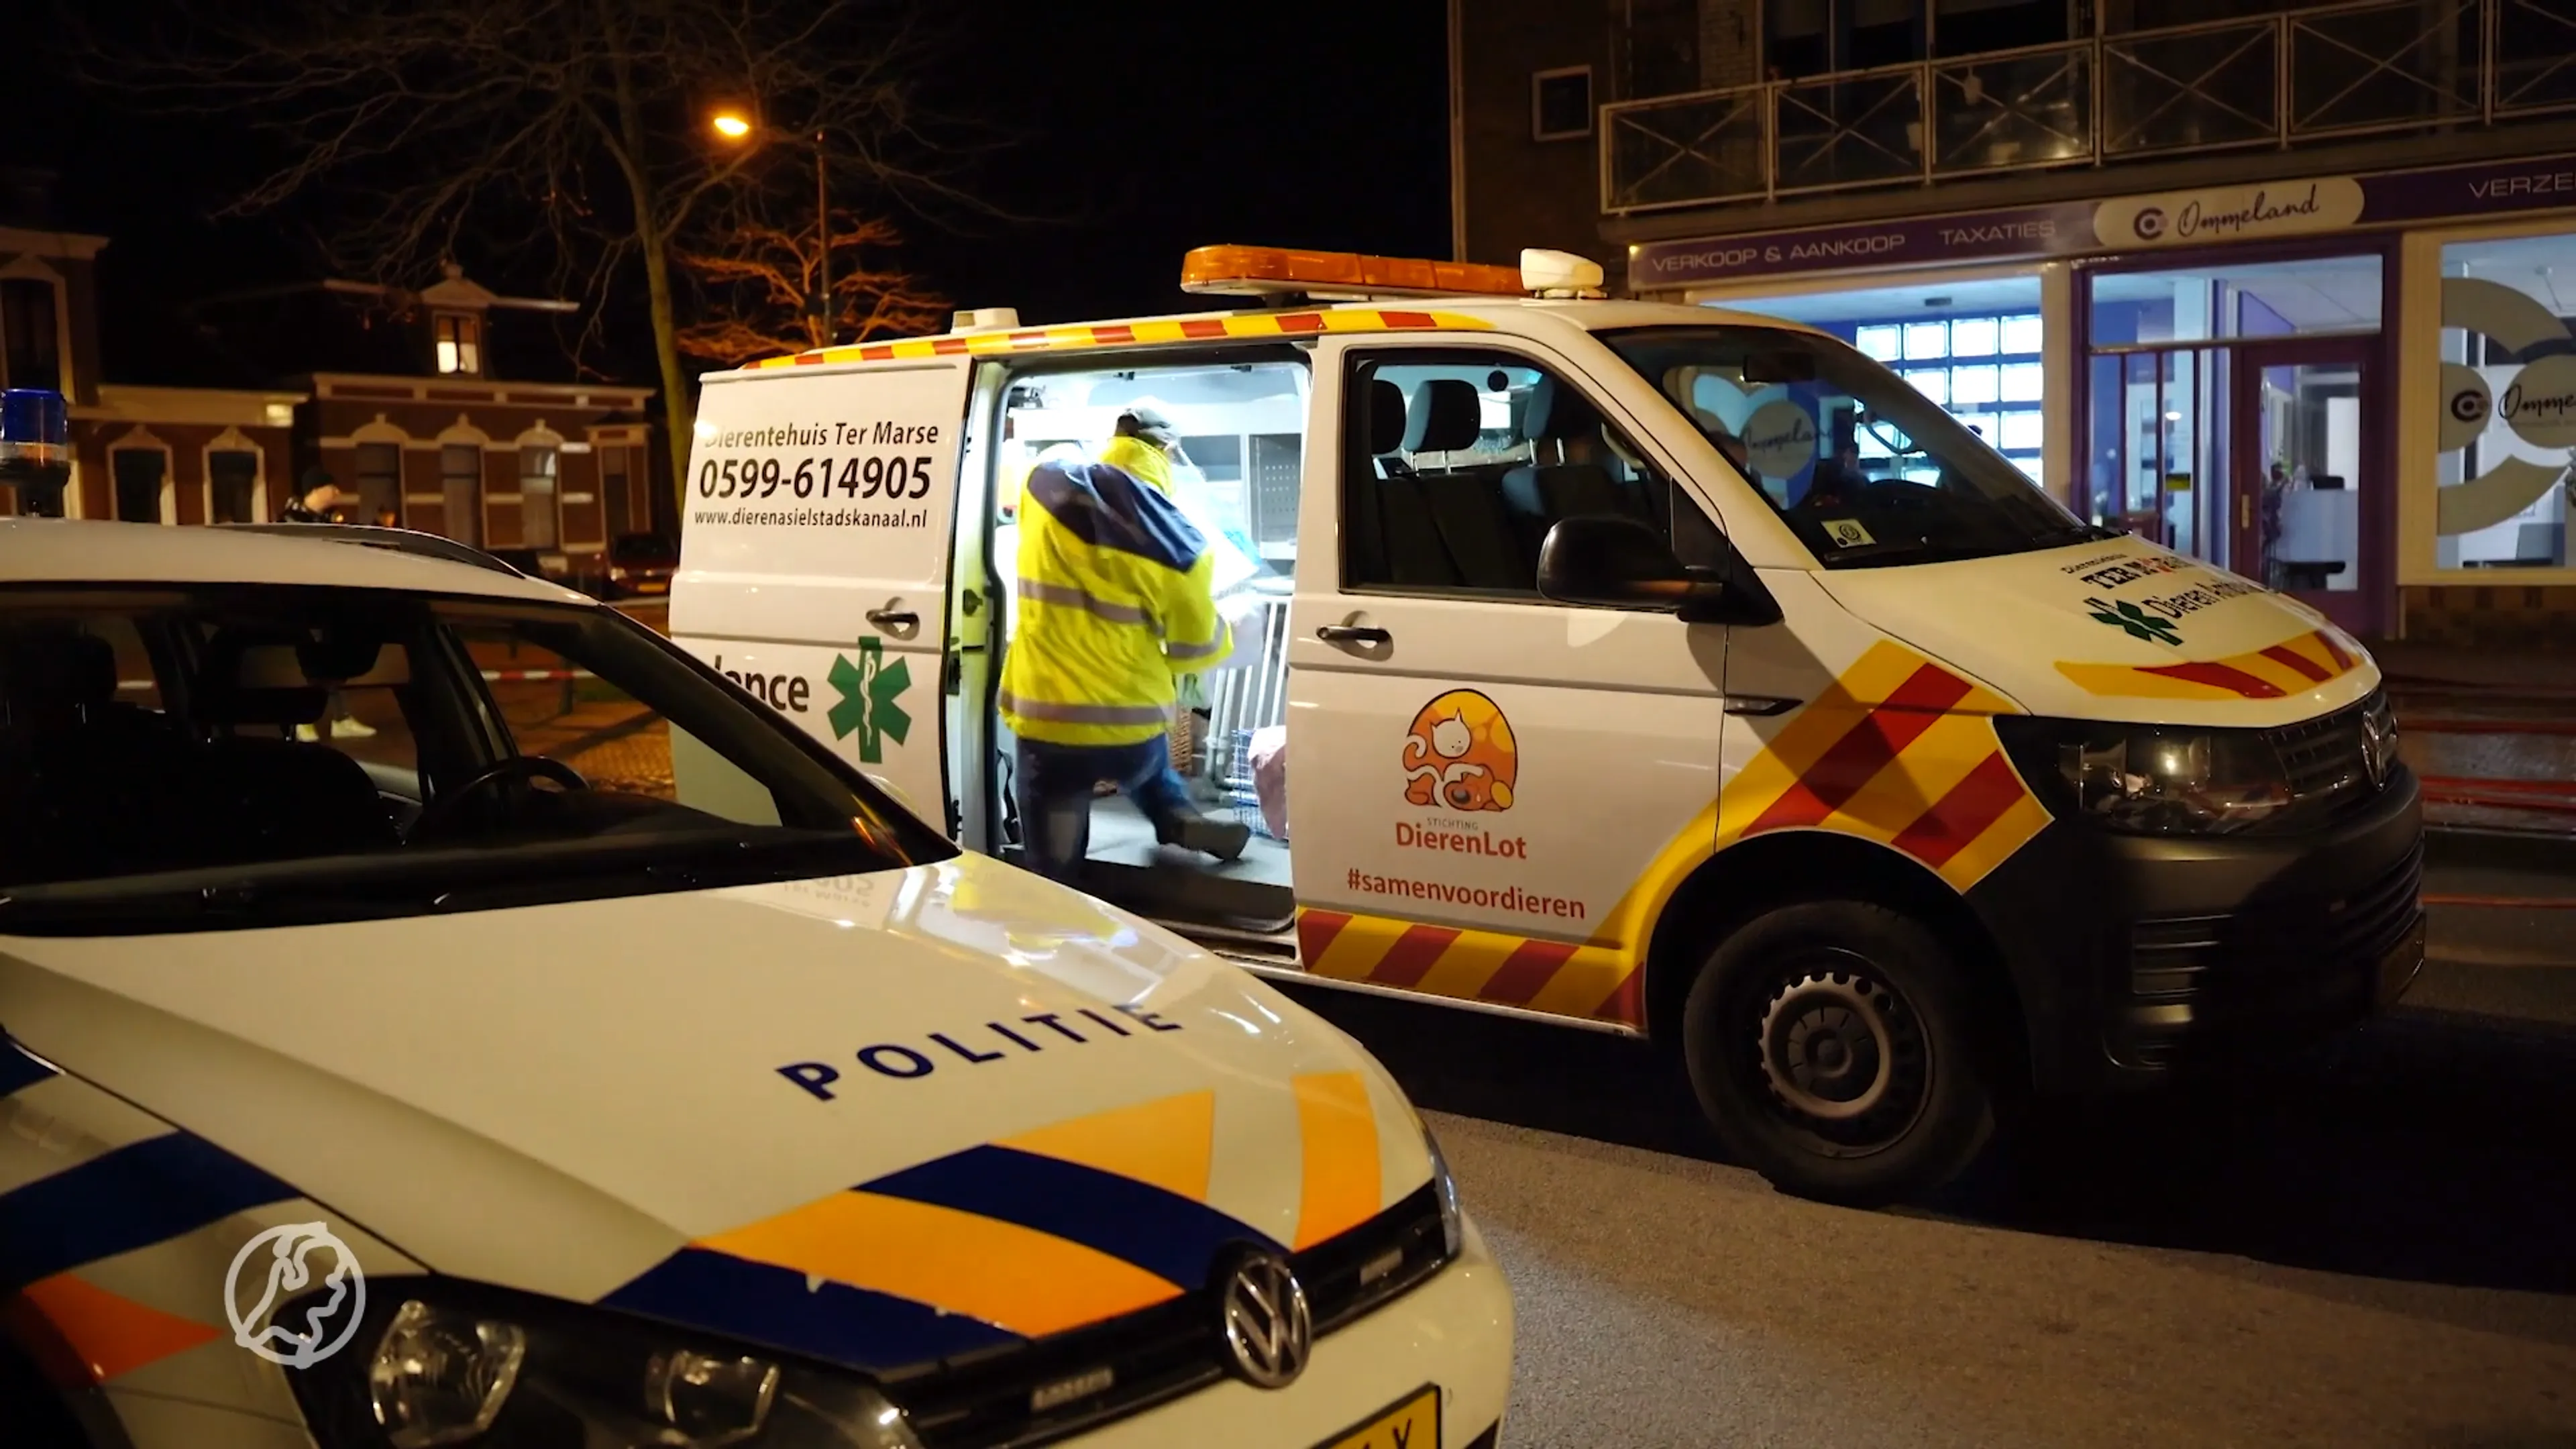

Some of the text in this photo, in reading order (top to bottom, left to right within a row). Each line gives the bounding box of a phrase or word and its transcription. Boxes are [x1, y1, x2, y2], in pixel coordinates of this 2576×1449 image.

[2469, 172, 2576, 199] VERZE
[2178, 183, 2320, 237] Ommeland
[1939, 220, 2056, 246] TAXATIES
[1652, 235, 1906, 272] VERKOOP & AANKOOP
[835, 422, 868, 445] Ter
[873, 421, 939, 445] Marse
[699, 455, 933, 500] 0599-614905
[694, 506, 927, 529] www.dierenasielstadskanaal.nl
[1395, 821, 1527, 859] DierenLot
[1427, 817, 1479, 830] STICHTING
[1347, 867, 1586, 919] #samenvoordieren
[775, 1004, 1183, 1102] POLITIE
